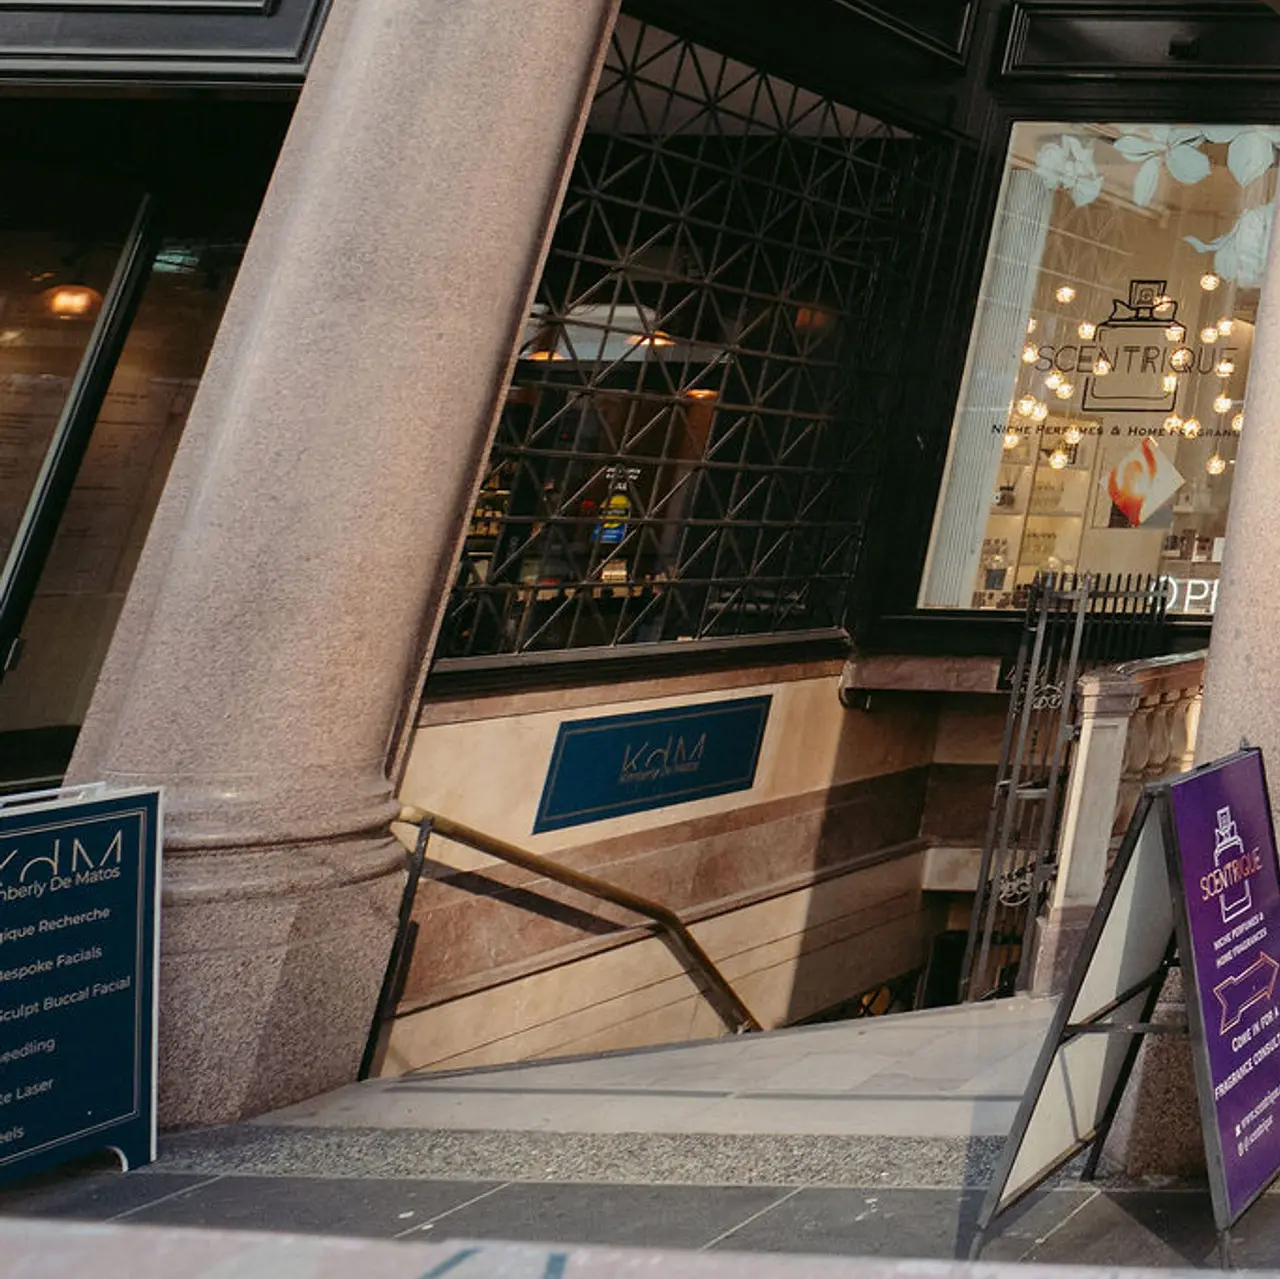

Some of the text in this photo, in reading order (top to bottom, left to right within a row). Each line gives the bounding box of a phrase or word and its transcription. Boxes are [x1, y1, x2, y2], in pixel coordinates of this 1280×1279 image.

[1034, 344, 1240, 375] SCENTRIQUE
[1110, 424, 1120, 437] &
[50, 875, 72, 892] De
[75, 867, 121, 887] Matos
[1200, 846, 1263, 901] SCENTRIQUE
[39, 907, 111, 933] Recherche
[56, 947, 103, 967] Facials
[43, 987, 90, 1010] Buccal
[91, 976, 132, 999] Facial
[16, 1079, 54, 1100] Laser
